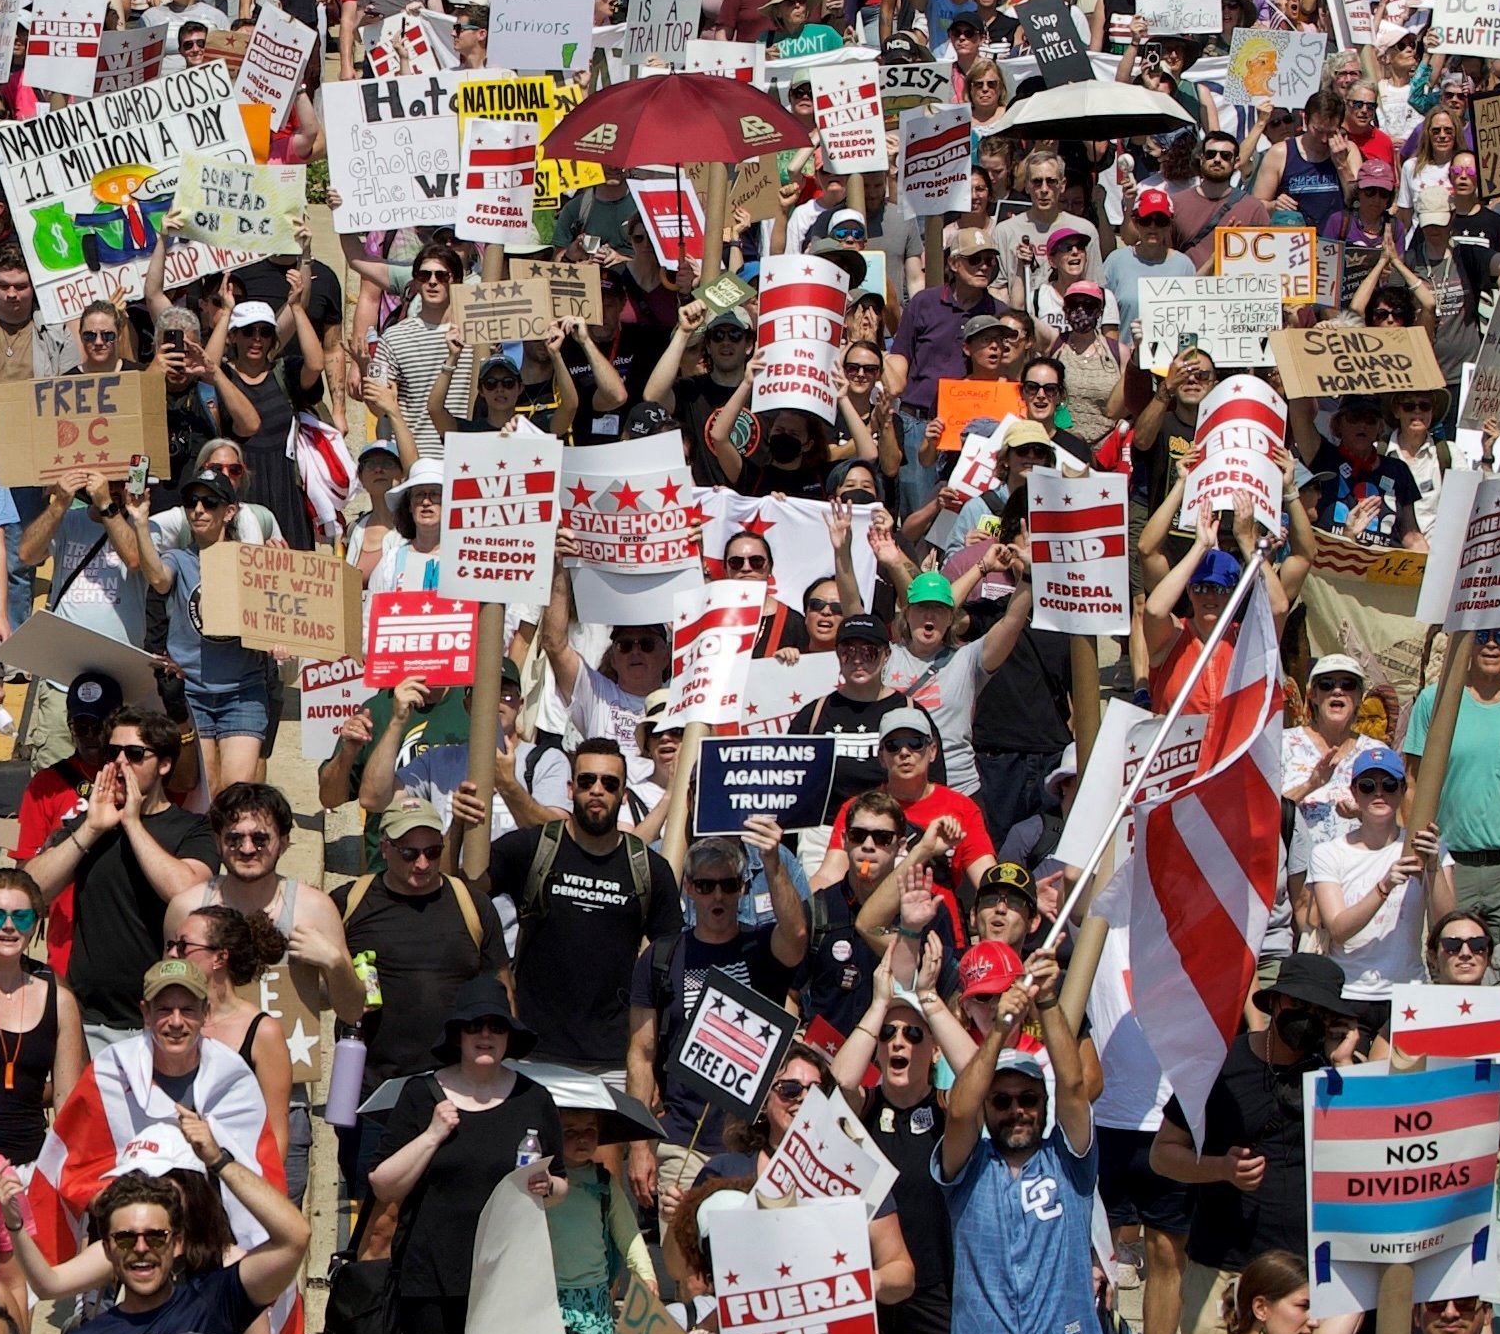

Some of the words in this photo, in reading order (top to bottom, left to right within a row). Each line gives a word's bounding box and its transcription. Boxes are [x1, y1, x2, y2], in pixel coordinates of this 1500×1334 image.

[638, 1, 652, 23] IS
[668, 1, 678, 23] A
[630, 22, 691, 55] TRAITOR
[3, 115, 103, 165] NATIONAL
[104, 88, 159, 126] GUARD
[161, 65, 230, 109] COSTS
[58, 134, 149, 180] MILLION
[160, 126, 179, 153] A
[187, 105, 226, 145] DAY
[1305, 333, 1384, 361] SEND
[1335, 354, 1410, 372] GUARD
[1322, 369, 1412, 391] HOME!!!
[239, 547, 297, 570] SCHOOL
[301, 558, 342, 576] ISN'T
[242, 570, 279, 590] SAFE
[288, 576, 334, 597] WITH
[264, 591, 308, 616] ICE
[242, 611, 262, 625] ON
[264, 617, 286, 633] THE
[294, 622, 336, 642] ROADS
[718, 745, 816, 763] VETERANS
[723, 770, 806, 787] AGAINST
[729, 793, 798, 811] TRUMP
[551, 885, 628, 905] DEMOCRACY
[562, 873, 594, 887] VETS
[597, 881, 620, 894] FOR
[1394, 1110, 1433, 1134] NO
[1386, 1138, 1438, 1162] NOS
[1346, 1160, 1471, 1198] DIVIDIRÁS
